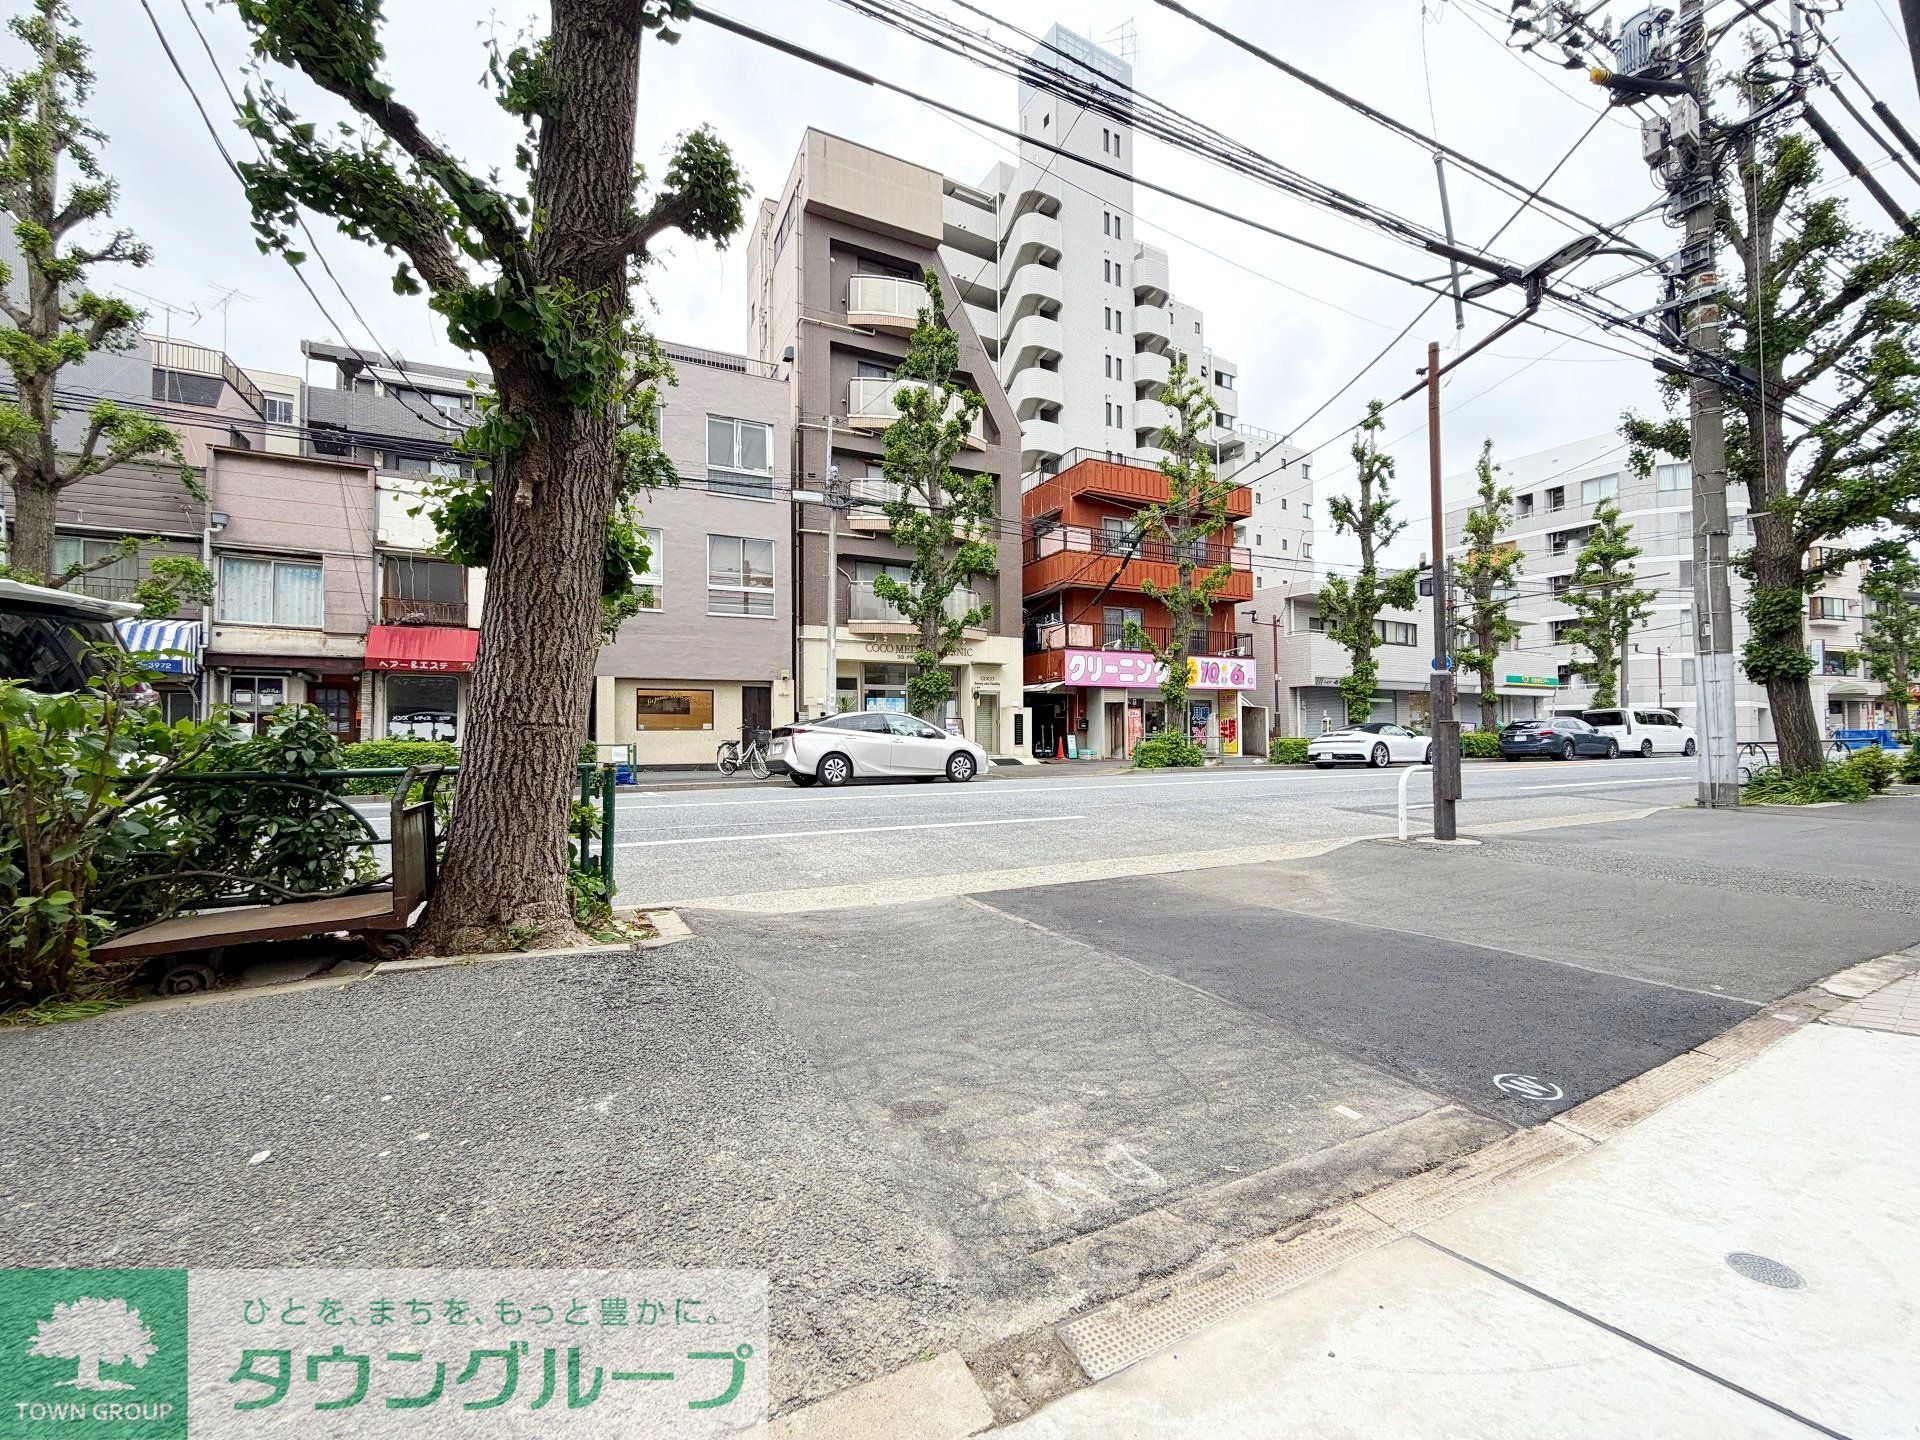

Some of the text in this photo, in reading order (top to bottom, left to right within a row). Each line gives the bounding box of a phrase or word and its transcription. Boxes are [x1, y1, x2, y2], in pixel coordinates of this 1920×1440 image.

[865, 643, 894, 652] COCO
[1068, 655, 1170, 684] クリーニング
